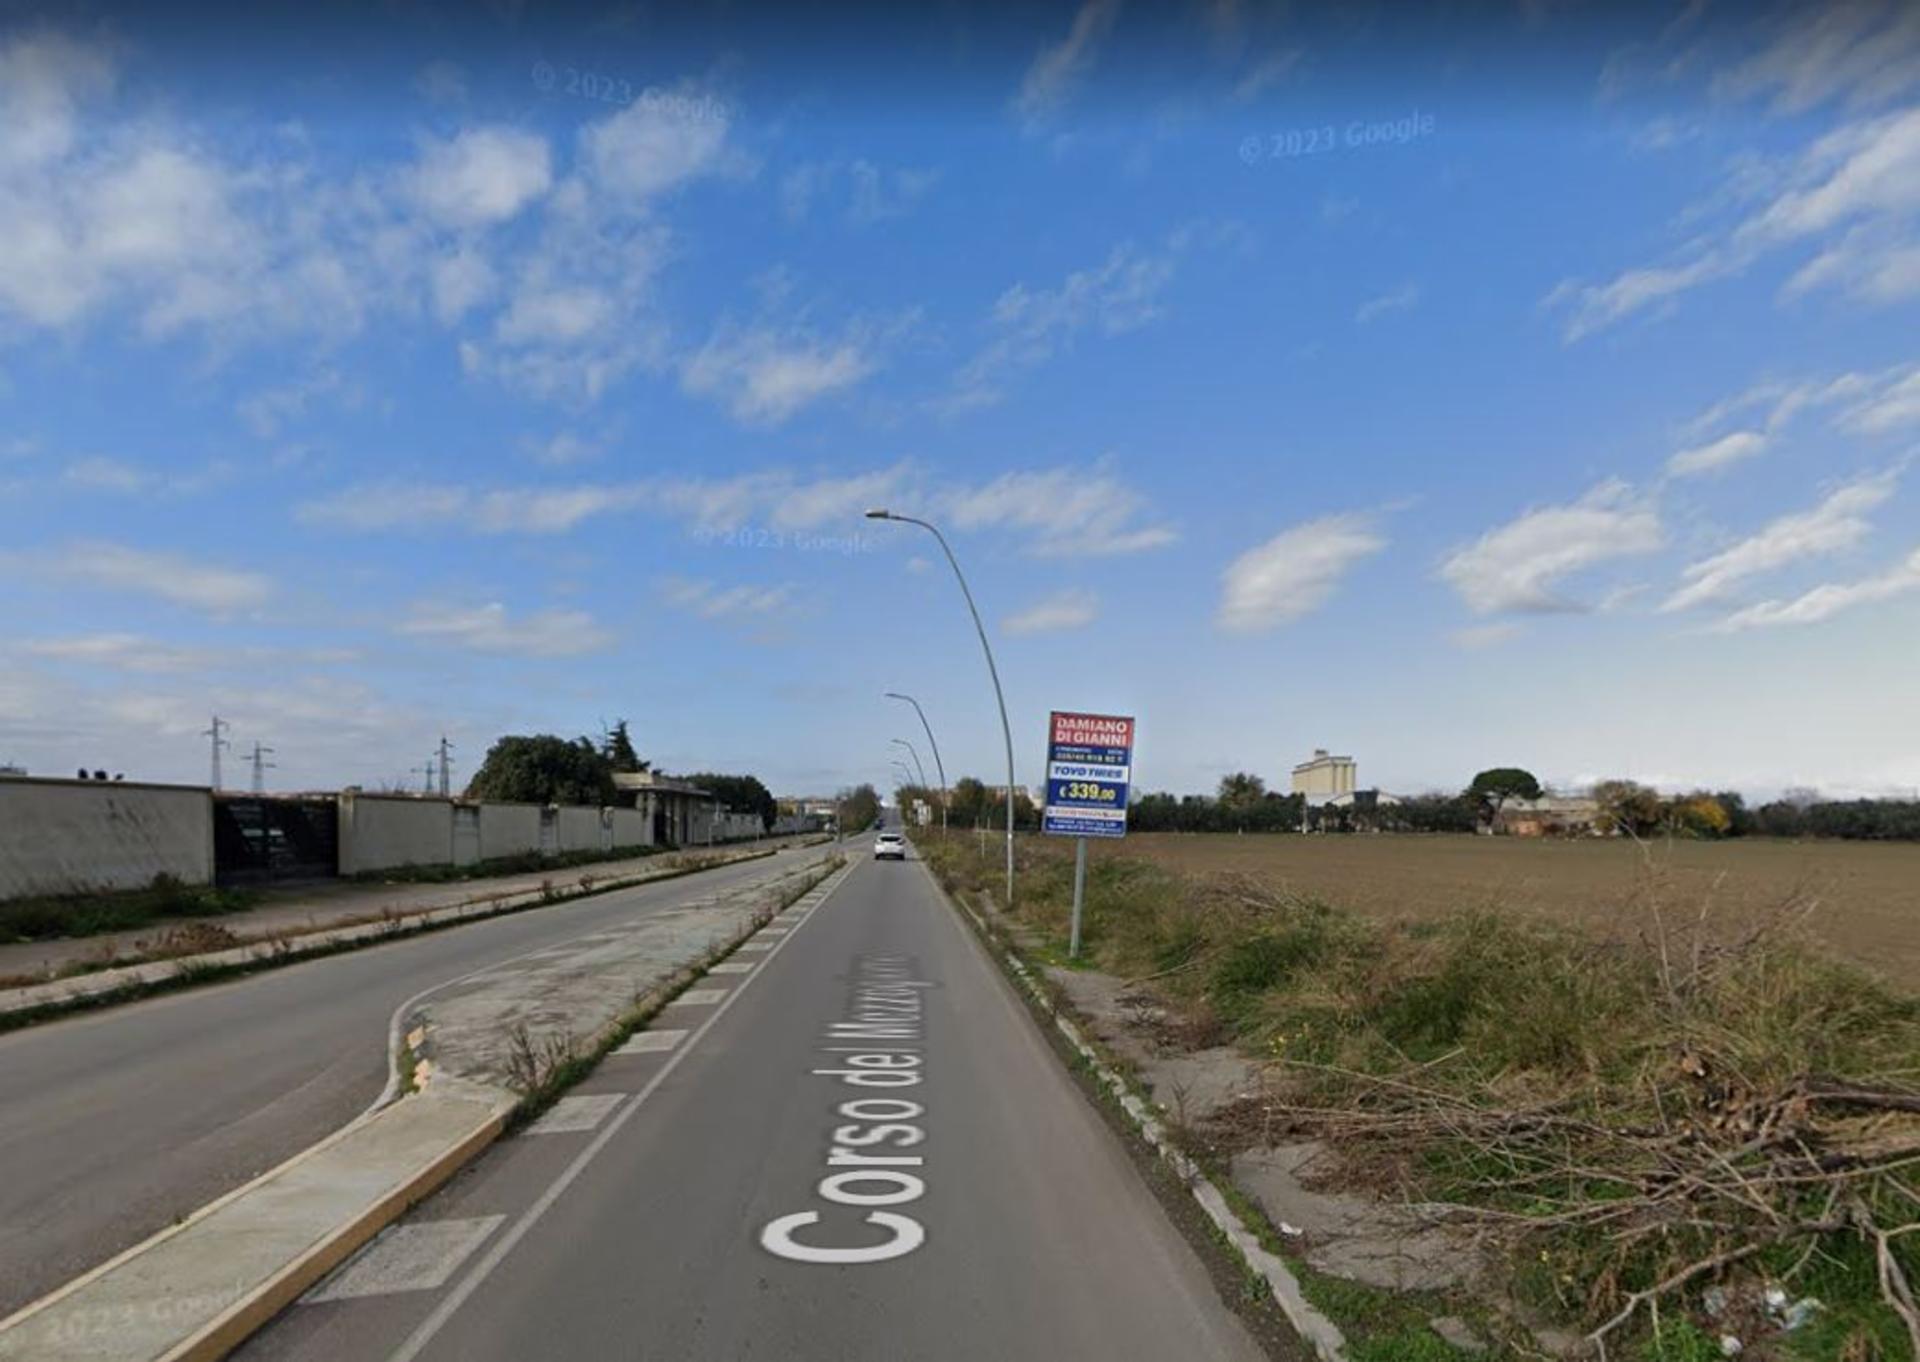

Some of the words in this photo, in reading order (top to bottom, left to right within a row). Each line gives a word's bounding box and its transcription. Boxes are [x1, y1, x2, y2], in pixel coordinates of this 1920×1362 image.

[1057, 718, 1127, 733] DAMIANO
[1055, 730, 1071, 743] DI
[1073, 731, 1127, 747] GIANNI
